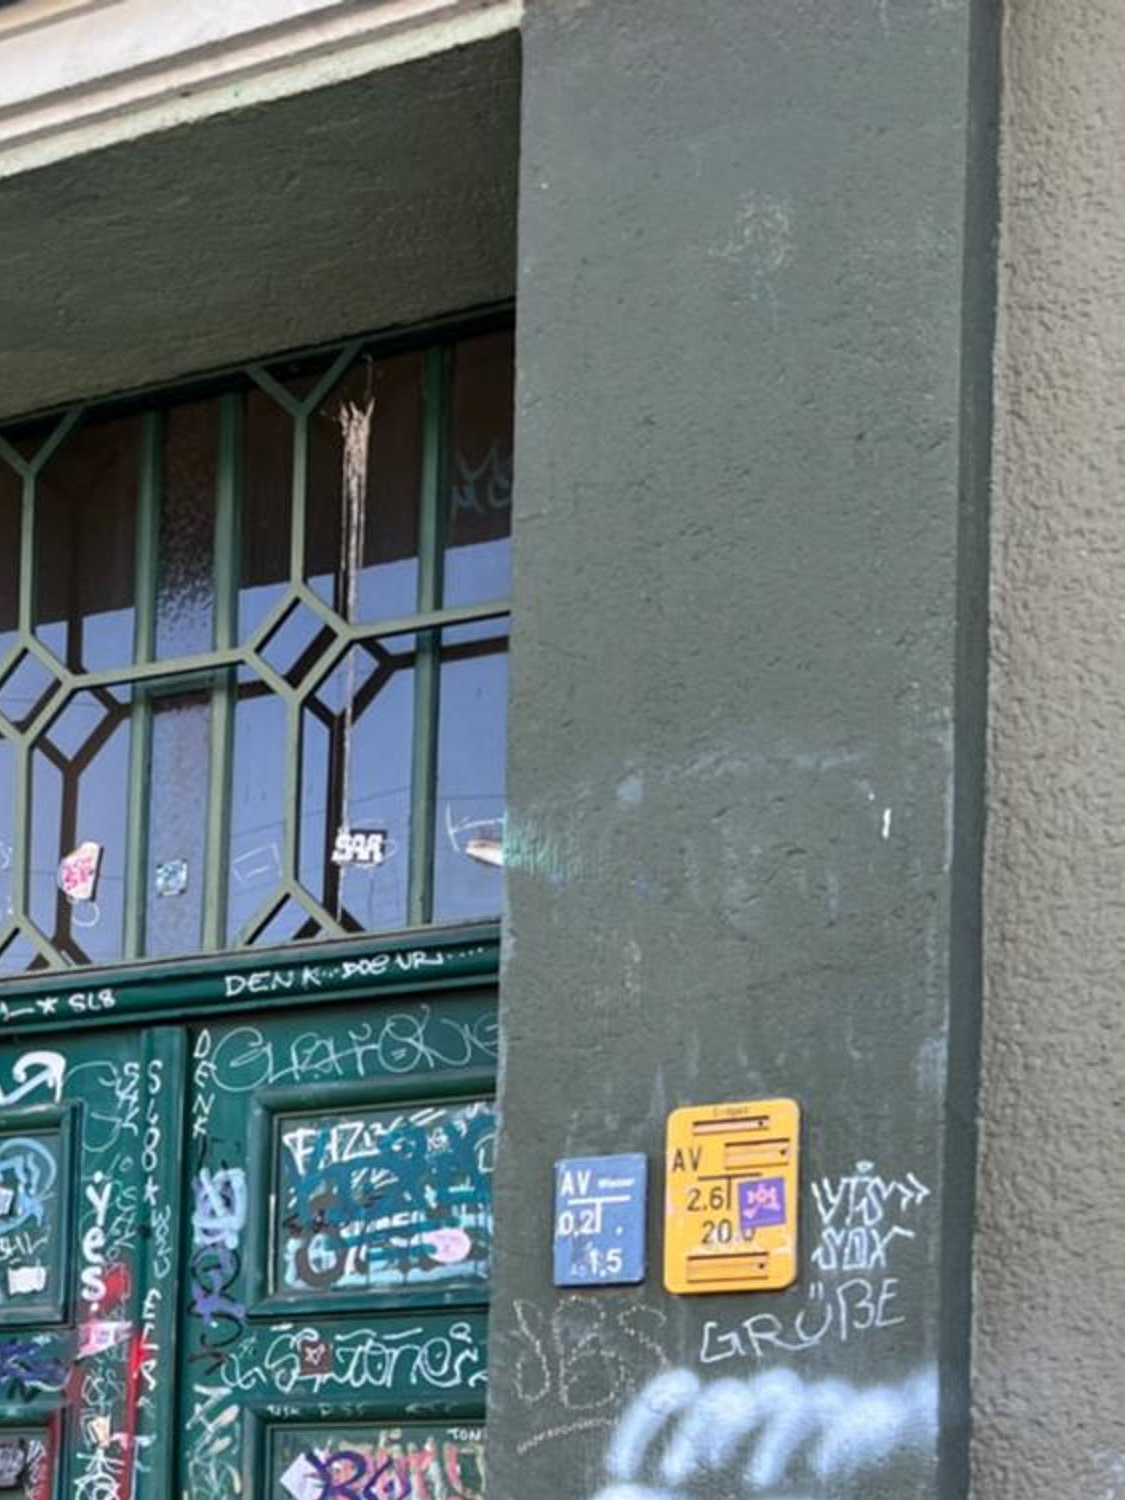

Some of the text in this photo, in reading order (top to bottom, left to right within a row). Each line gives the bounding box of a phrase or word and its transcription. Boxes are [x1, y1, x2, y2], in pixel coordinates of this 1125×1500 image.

[672, 1148, 703, 1173] AV
[561, 1170, 592, 1196] AV
[687, 1187, 724, 1213] 2.6
[557, 1211, 595, 1237] 0.2
